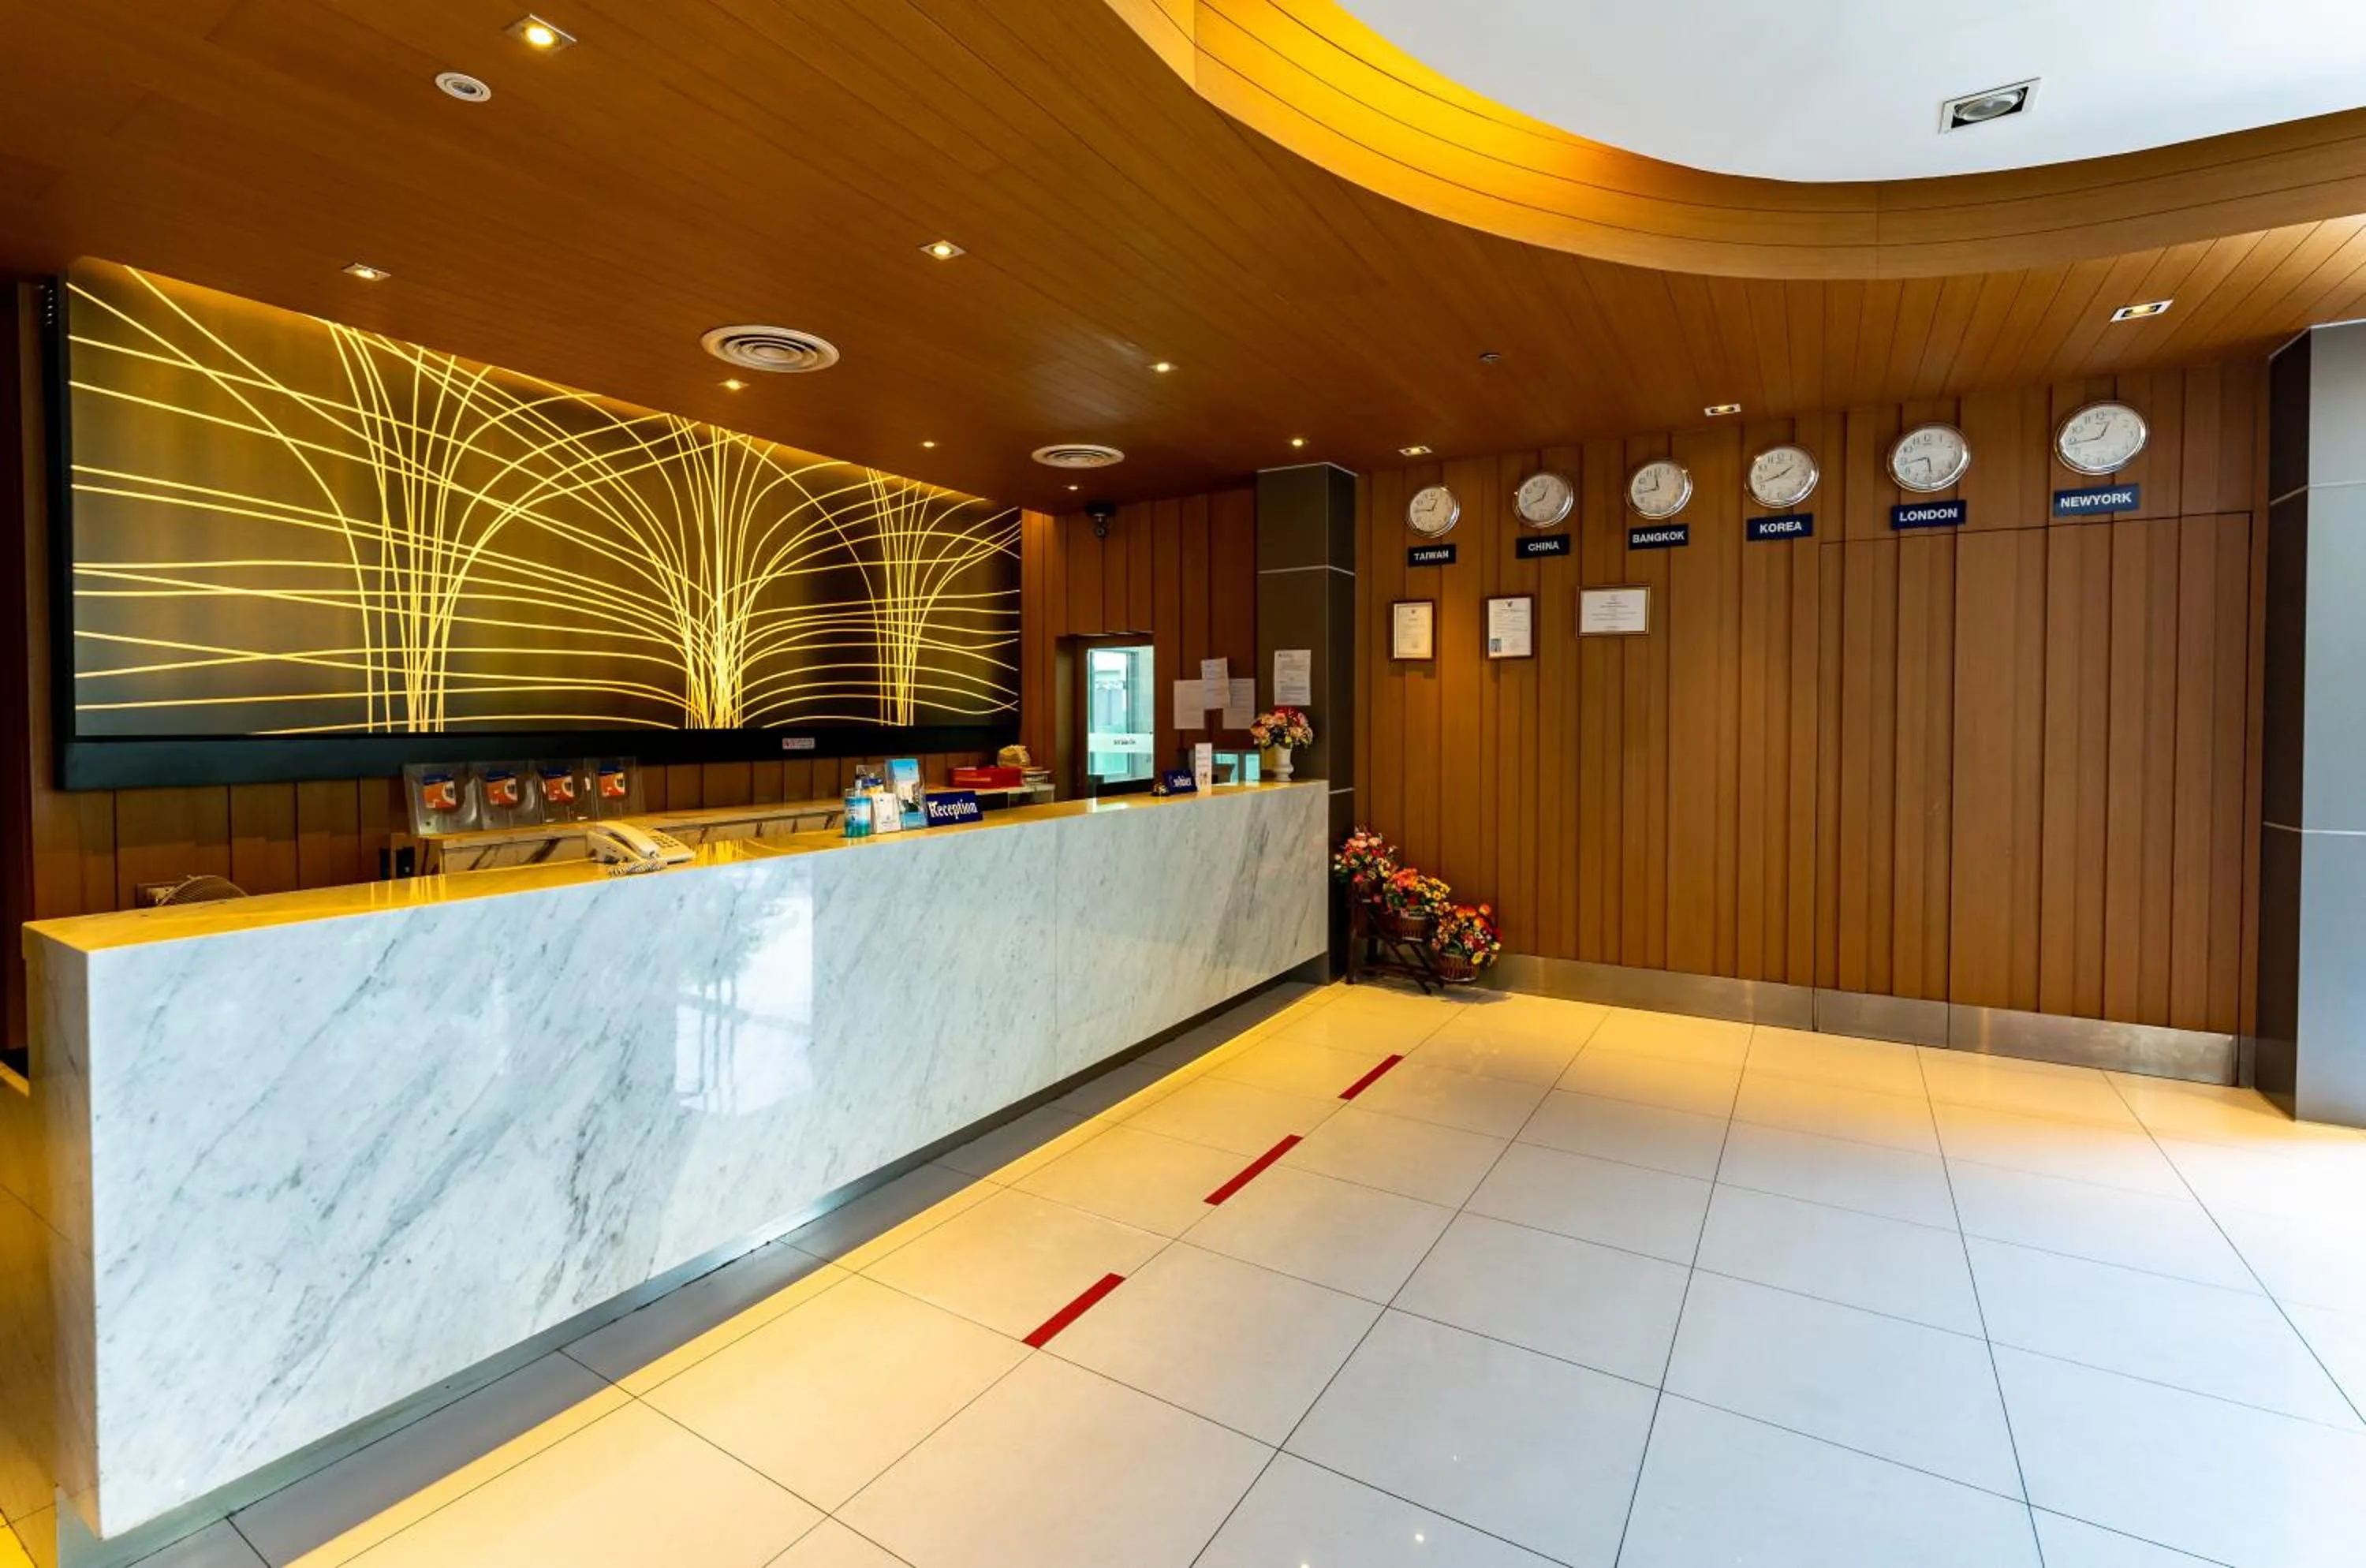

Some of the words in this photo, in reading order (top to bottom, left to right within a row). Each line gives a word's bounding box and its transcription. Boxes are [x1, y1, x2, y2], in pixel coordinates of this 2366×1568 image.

[2060, 491, 2132, 508] NEWYORK
[1899, 507, 1957, 521] LONDON
[1760, 521, 1802, 534] KOREA
[1632, 530, 1685, 543] BANGKOK
[1528, 540, 1559, 551] CHINA
[1413, 550, 1449, 561] TAIWAN
[927, 798, 978, 819] Reception
